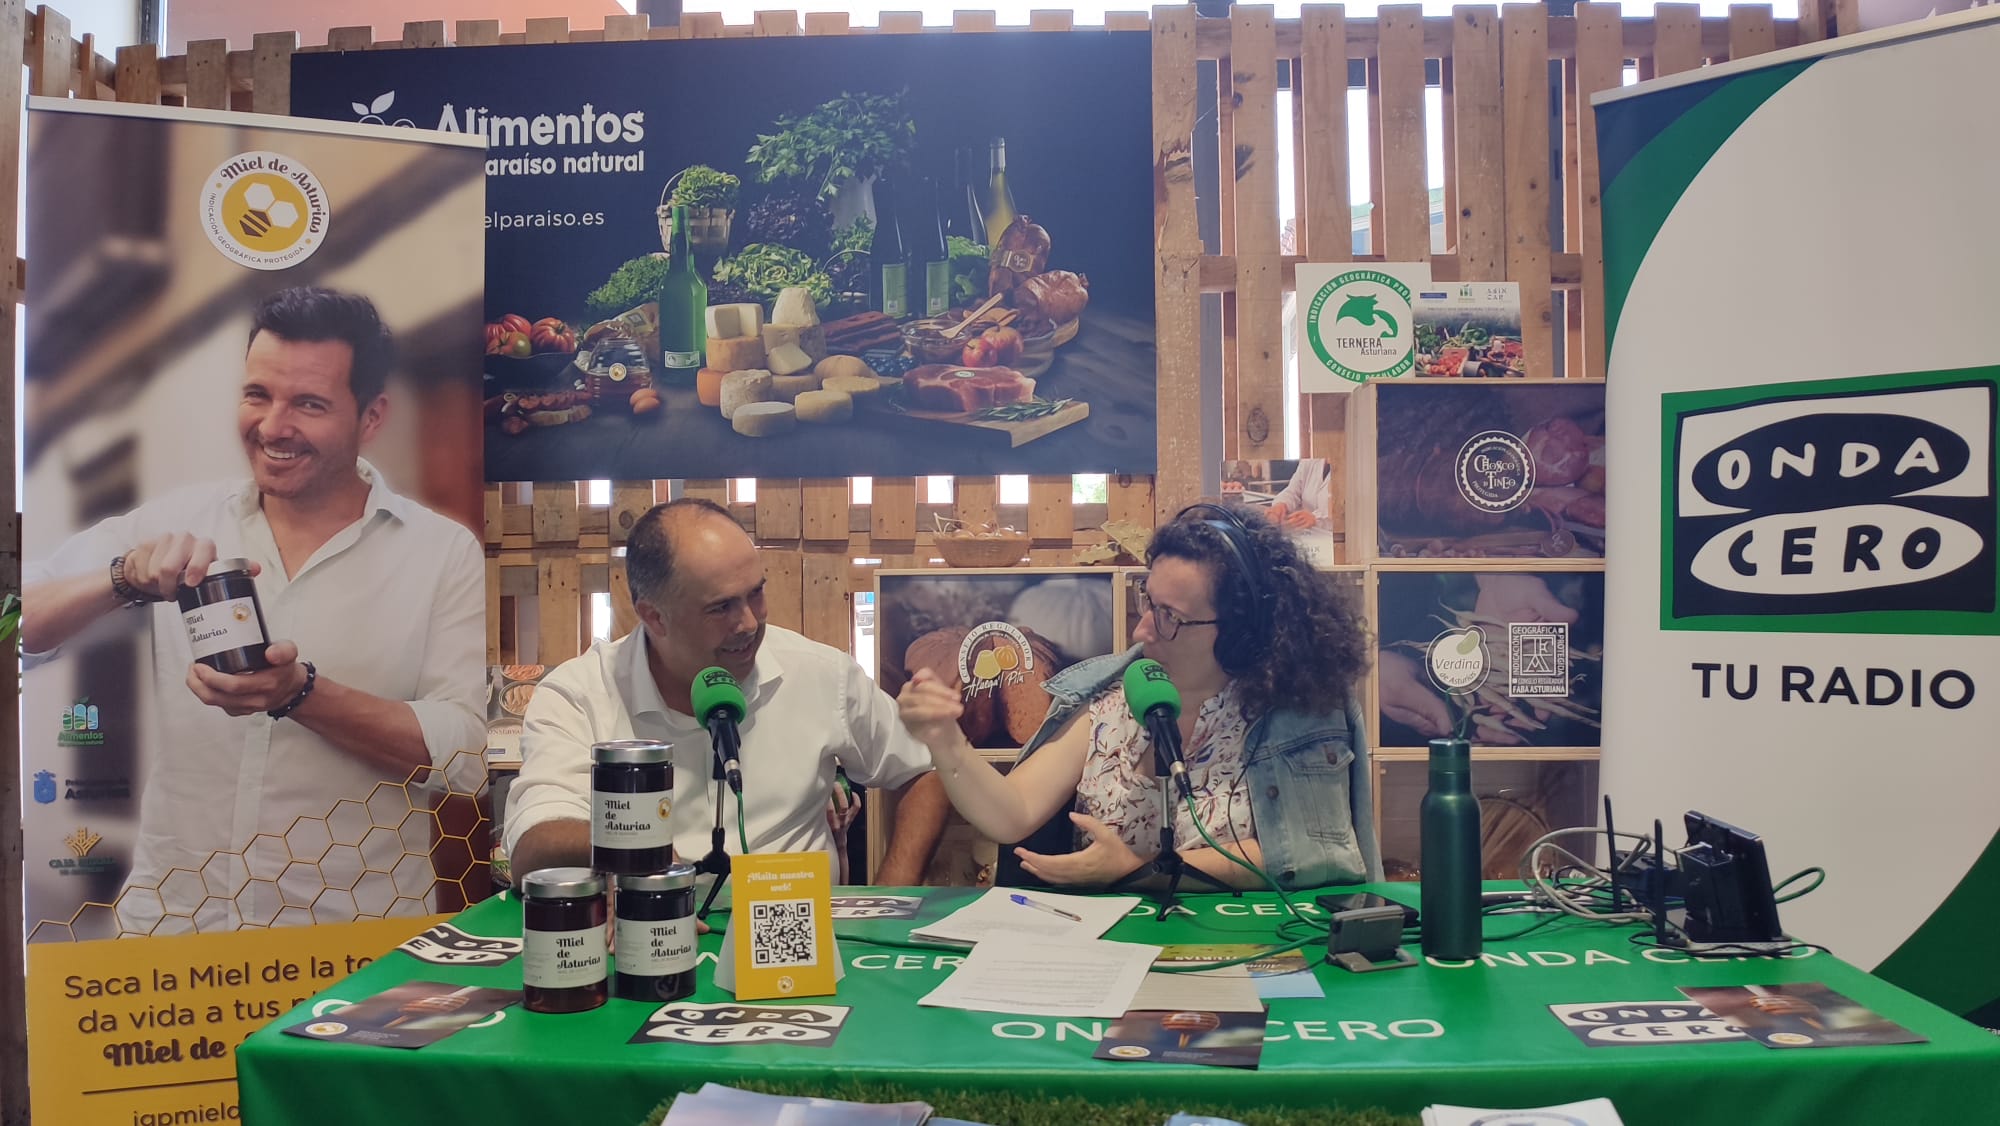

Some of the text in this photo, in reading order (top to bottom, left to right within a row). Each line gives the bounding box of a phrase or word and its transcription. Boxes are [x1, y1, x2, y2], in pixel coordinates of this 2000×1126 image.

[437, 103, 645, 147] Alimentos
[485, 150, 645, 175] araíso natural
[220, 156, 326, 233] Miel de Asturias
[484, 210, 605, 231] elparaiso.es
[208, 193, 305, 264] INDICACIÓN GEOGRÁFICA PROTEGIDA
[1308, 280, 1339, 324] INDICACIÓN
[1339, 271, 1391, 284] GEOGRÁFICA
[1336, 337, 1383, 349] TERNERA
[1360, 347, 1398, 356] Asturiana
[1326, 358, 1361, 381] CONSEJO
[1717, 436, 1940, 490] ONDA
[1728, 524, 1941, 577] CERO
[1512, 626, 1558, 635] GEOGRÁFICA
[981, 622, 1031, 662] REGULADOR
[1512, 635, 1520, 676] INDICACIÓN
[1557, 634, 1565, 676] PROTEGIDA
[1435, 658, 1481, 670] Verdina
[1439, 672, 1448, 681] de
[1512, 685, 1565, 693] FABA ASTURIANA
[1691, 662, 1975, 710] TU RADIO
[605, 800, 631, 810] Miel
[605, 811, 617, 820] de
[605, 821, 651, 832] Asturias
[831, 898, 899, 907] NDA
[1215, 903, 1321, 917] CER
[650, 925, 677, 937] Miel
[555, 936, 585, 948] Miel
[650, 937, 664, 948] de
[556, 949, 571, 959] de
[650, 944, 692, 958] Asturias
[556, 956, 601, 970] Asturias
[851, 954, 966, 971] CER
[65, 975, 141, 999] Saca
[153, 968, 178, 992] la
[189, 962, 250, 990] Miel
[261, 958, 299, 983] de
[310, 954, 335, 978] la
[78, 1009, 118, 1034] da
[128, 1002, 195, 1028] vida
[205, 1005, 223, 1023] a
[233, 999, 280, 1021] tus
[680, 1009, 816, 1023] ONDA
[673, 1025, 808, 1038] CERO
[991, 1021, 1103, 1042] ON
[103, 1038, 184, 1067] Miel
[190, 1036, 228, 1060] de
